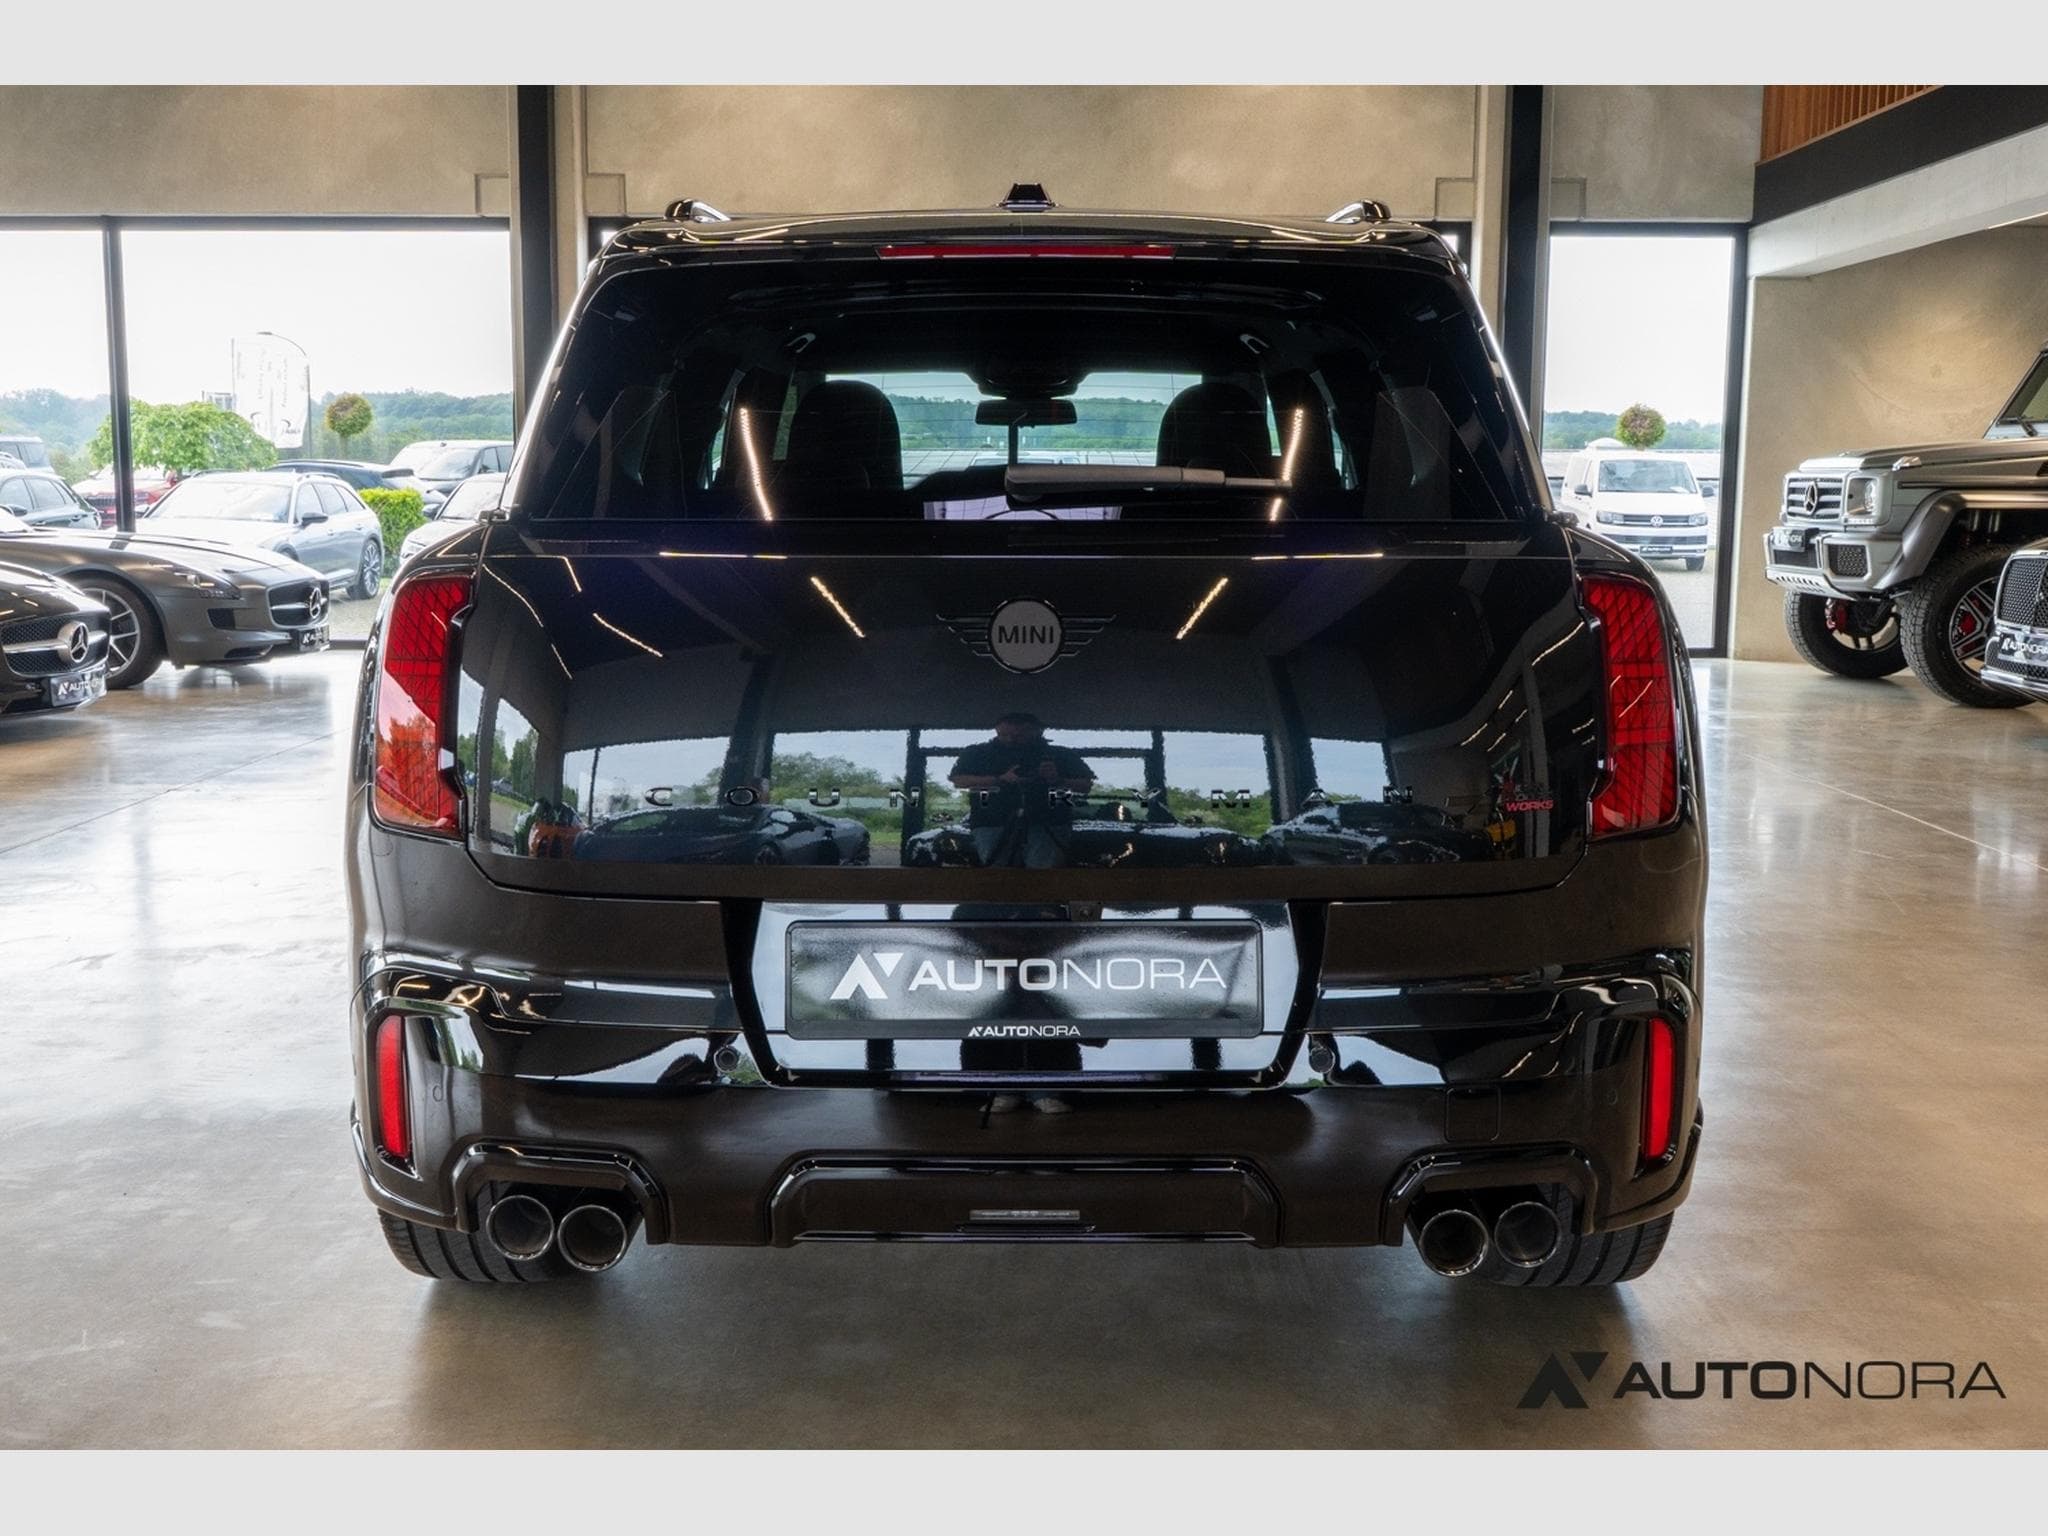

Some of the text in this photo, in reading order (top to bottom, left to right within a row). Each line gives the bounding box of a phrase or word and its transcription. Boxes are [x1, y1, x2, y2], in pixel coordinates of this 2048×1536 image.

[998, 625, 1054, 644] MINI
[1506, 799, 1553, 812] WORKS
[908, 957, 1227, 991] AUTONORA
[983, 1025, 1081, 1037] AUTONORA
